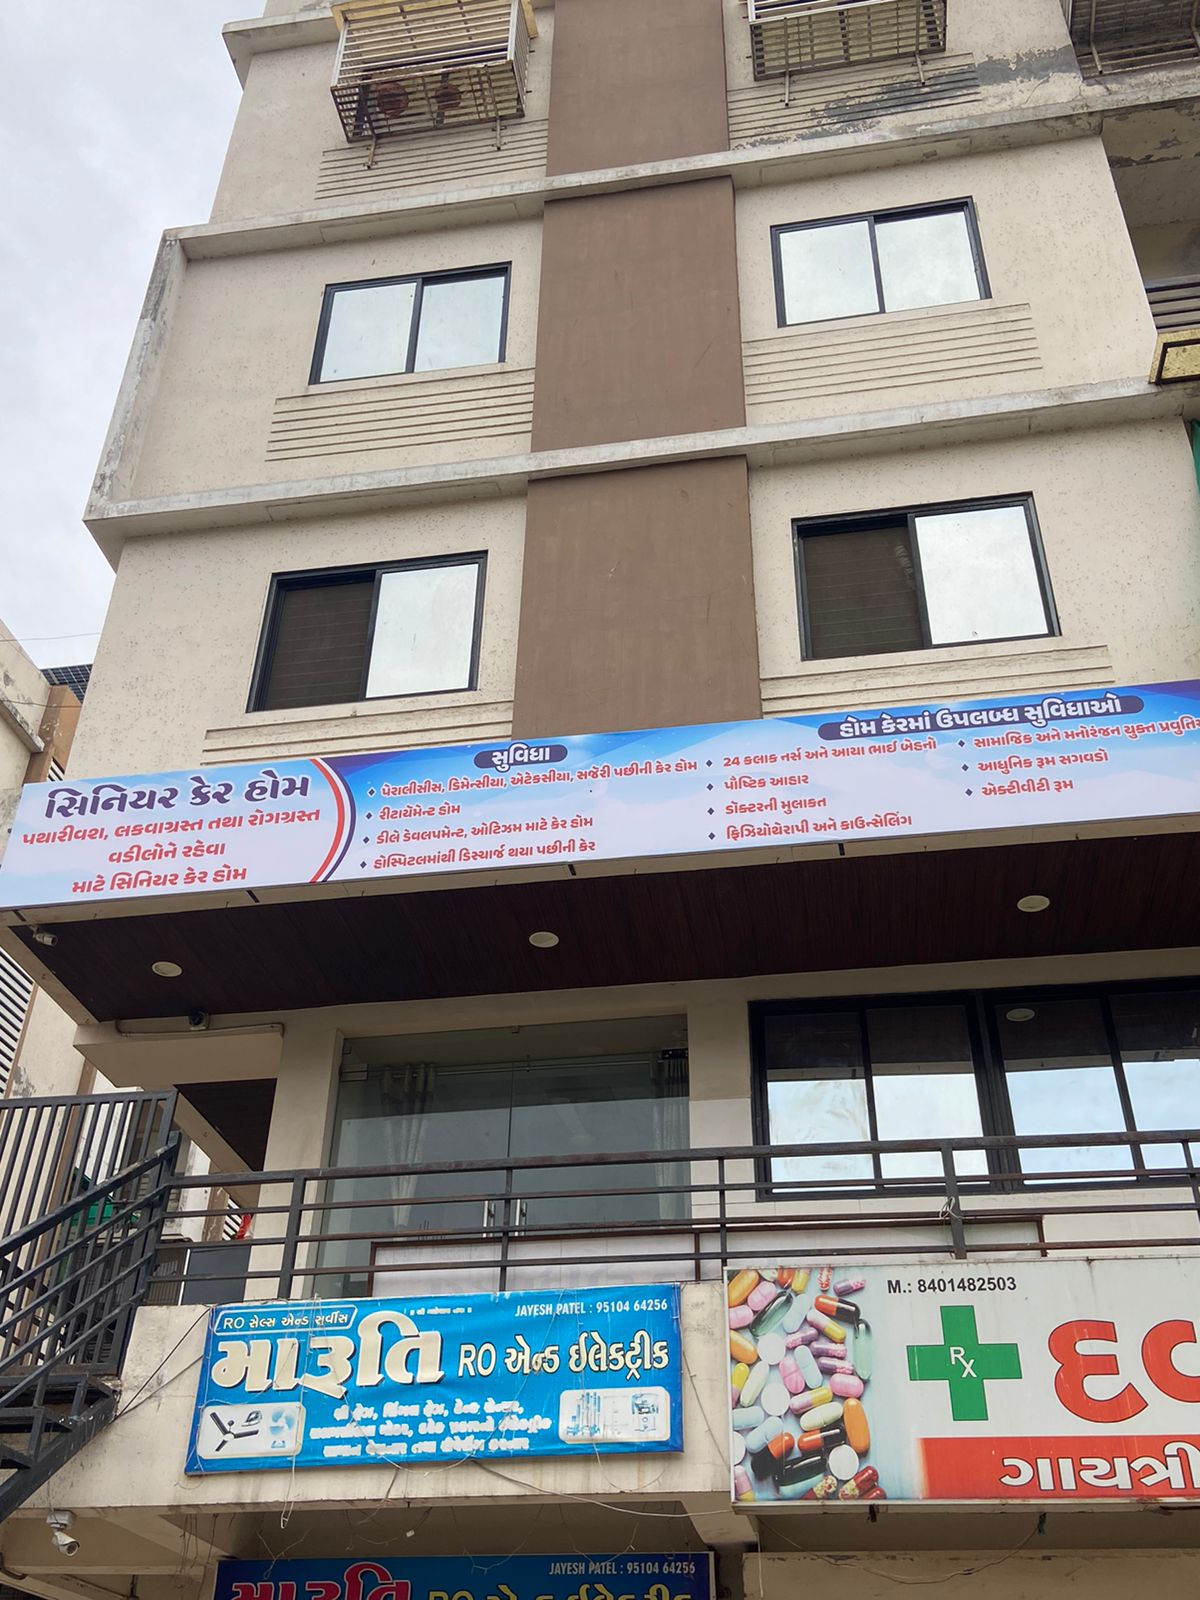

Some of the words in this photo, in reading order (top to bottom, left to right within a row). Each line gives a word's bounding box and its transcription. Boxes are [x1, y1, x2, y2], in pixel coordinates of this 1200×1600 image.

[839, 715, 876, 737] હોમ
[882, 712, 931, 733] કેરમાં
[937, 708, 1019, 728] ઉપલબ્ધ
[1024, 693, 1121, 727] સુવિધાઓ
[974, 731, 1032, 748] સામાજિક
[1036, 728, 1060, 742] અને
[1064, 725, 1121, 739] મનોરંજન
[491, 745, 550, 769] સુવિધા
[723, 756, 740, 767] 24
[744, 752, 778, 765] કલાક
[781, 746, 801, 762] નર્સ
[805, 747, 829, 760] અને
[831, 746, 865, 758] આયા
[868, 741, 897, 754] ભાઈ
[655, 760, 672, 773] કેર
[675, 758, 698, 772] હોમ
[977, 755, 1032, 774] આધુનિક
[1036, 756, 1055, 769] રૂમ
[769, 774, 809, 786] આહાર
[1054, 778, 1074, 793] રૂમ
[45, 784, 178, 819] સિનિયર
[190, 776, 232, 805] કેર
[244, 770, 309, 800] હોમ
[439, 800, 461, 815] હોમ
[114, 818, 203, 837] લકવાગ્રસ્ત
[208, 816, 242, 829] તથા
[376, 831, 400, 845] ડીલે
[526, 818, 548, 832] માટે
[552, 817, 568, 830] કેર
[571, 814, 593, 828] હોમ
[812, 818, 837, 833] અને
[108, 842, 177, 864] વડીલોને
[182, 840, 225, 858] રહેવા
[508, 845, 533, 858] થયા
[579, 838, 596, 853] કેર
[72, 875, 105, 893] માટે
[109, 871, 179, 891] સિનિયર
[183, 867, 208, 885] કેર
[212, 864, 247, 881] હોમ
[917, 1277, 1016, 1293] 8401482503
[515, 1305, 553, 1317] JAYESH
[556, 1303, 586, 1315] PATEL
[596, 1302, 629, 1313] 95104
[633, 1299, 668, 1311] 64256
[224, 1318, 244, 1330] RO
[212, 1311, 445, 1399] મારૂતિ
[458, 1342, 496, 1377] RO
[549, 1563, 585, 1575] JAYESH
[589, 1562, 616, 1574] PATEL
[627, 1562, 659, 1574] 95104
[663, 1562, 696, 1574] 64256
